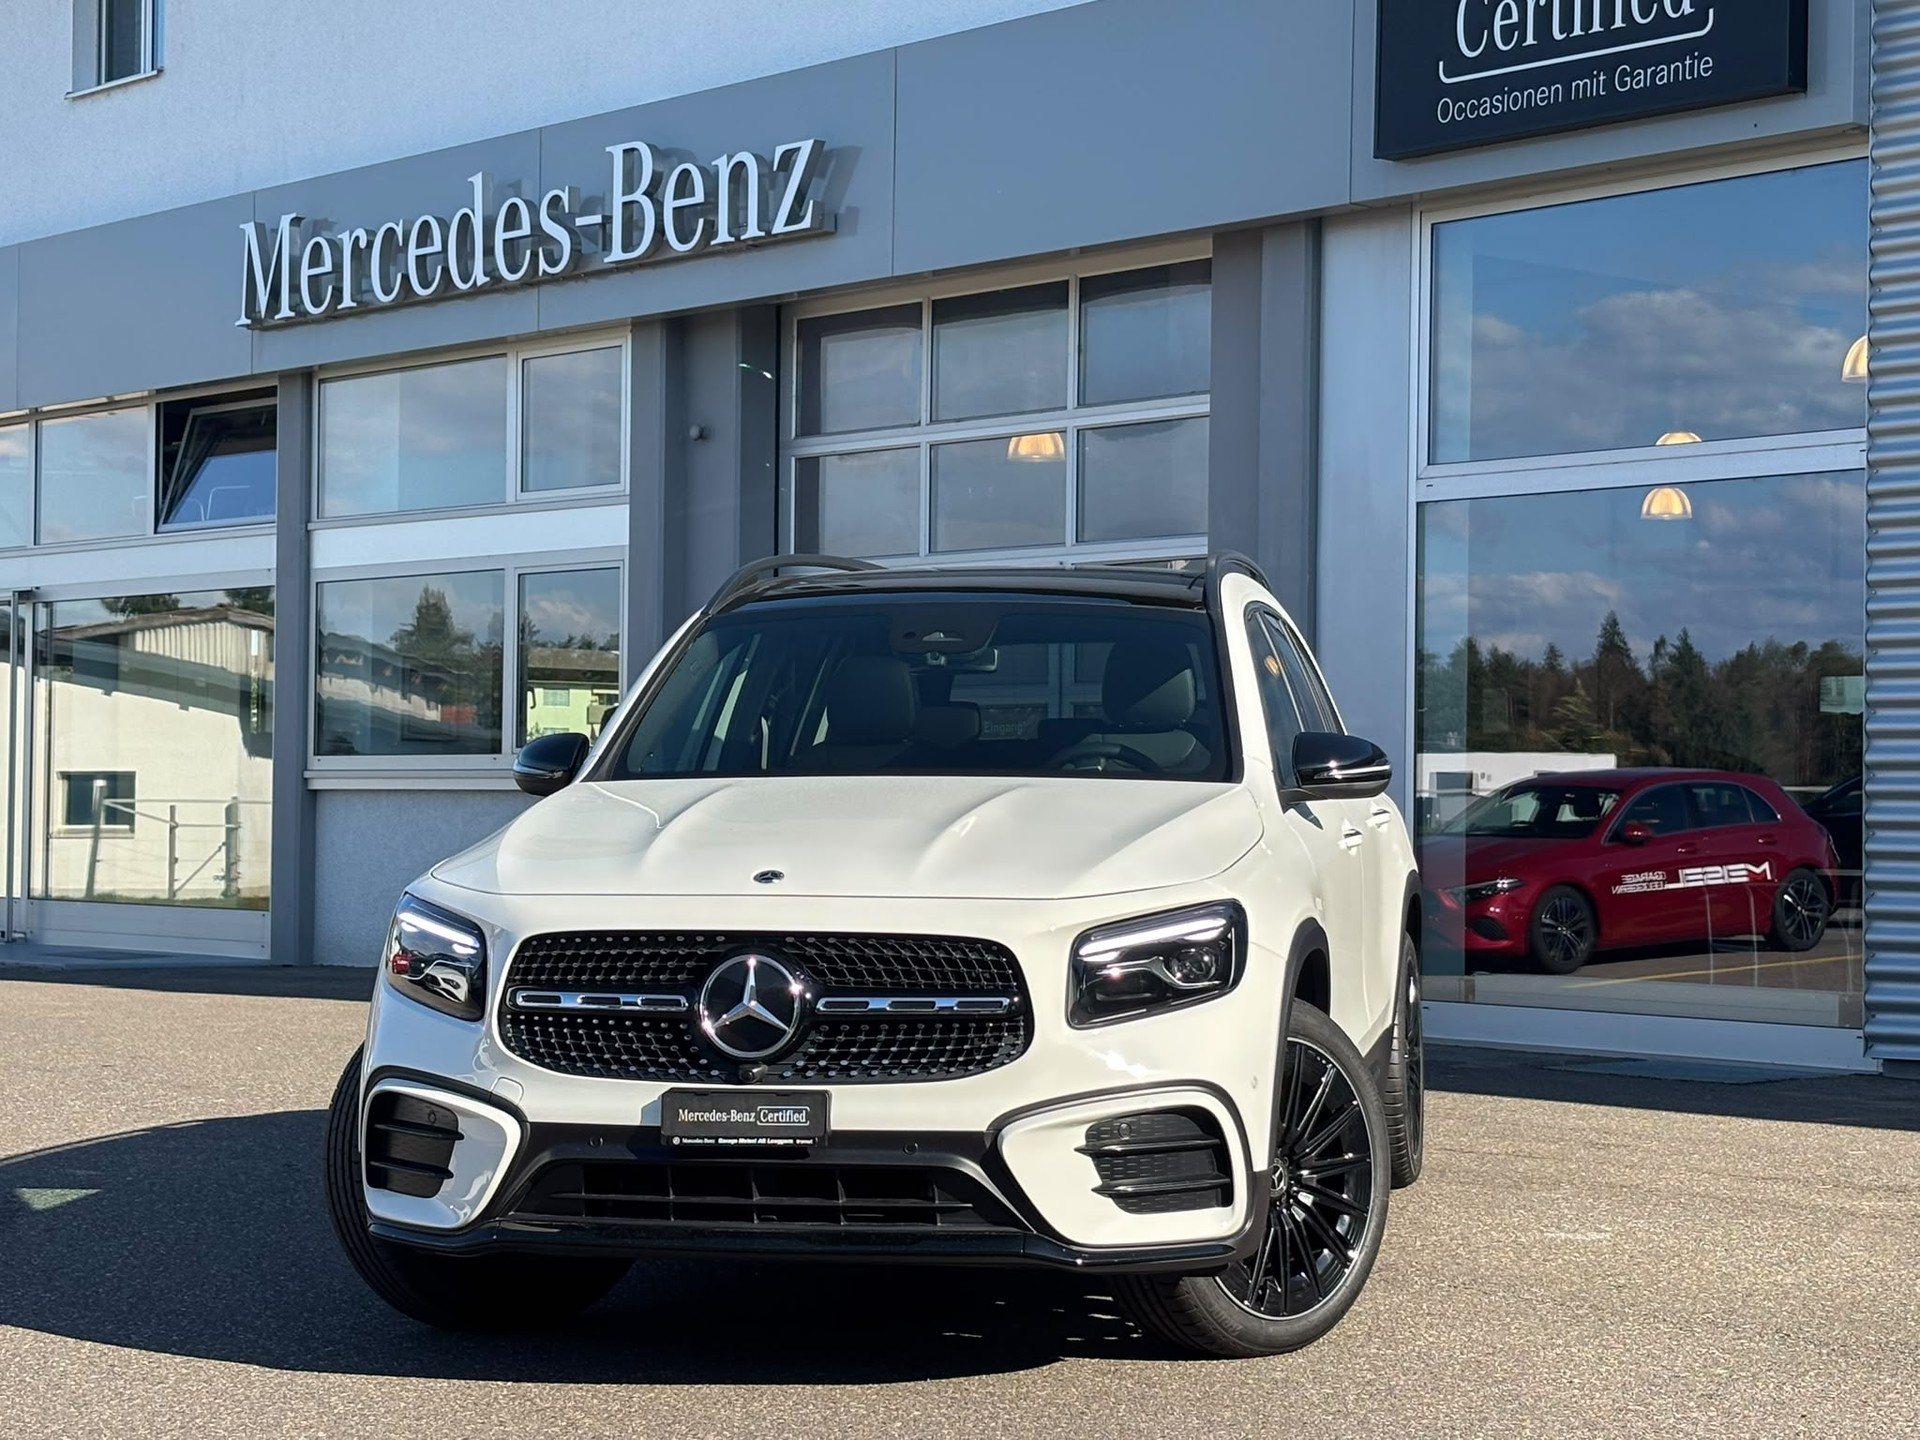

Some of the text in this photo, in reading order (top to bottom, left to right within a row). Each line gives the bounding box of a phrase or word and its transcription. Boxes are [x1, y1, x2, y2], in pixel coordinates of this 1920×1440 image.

[1437, 51, 1714, 124] Occasionen mit Garantie
[235, 138, 824, 328] Mercedes-Benz
[678, 1108, 806, 1123] Mercedes-Benz Certified
